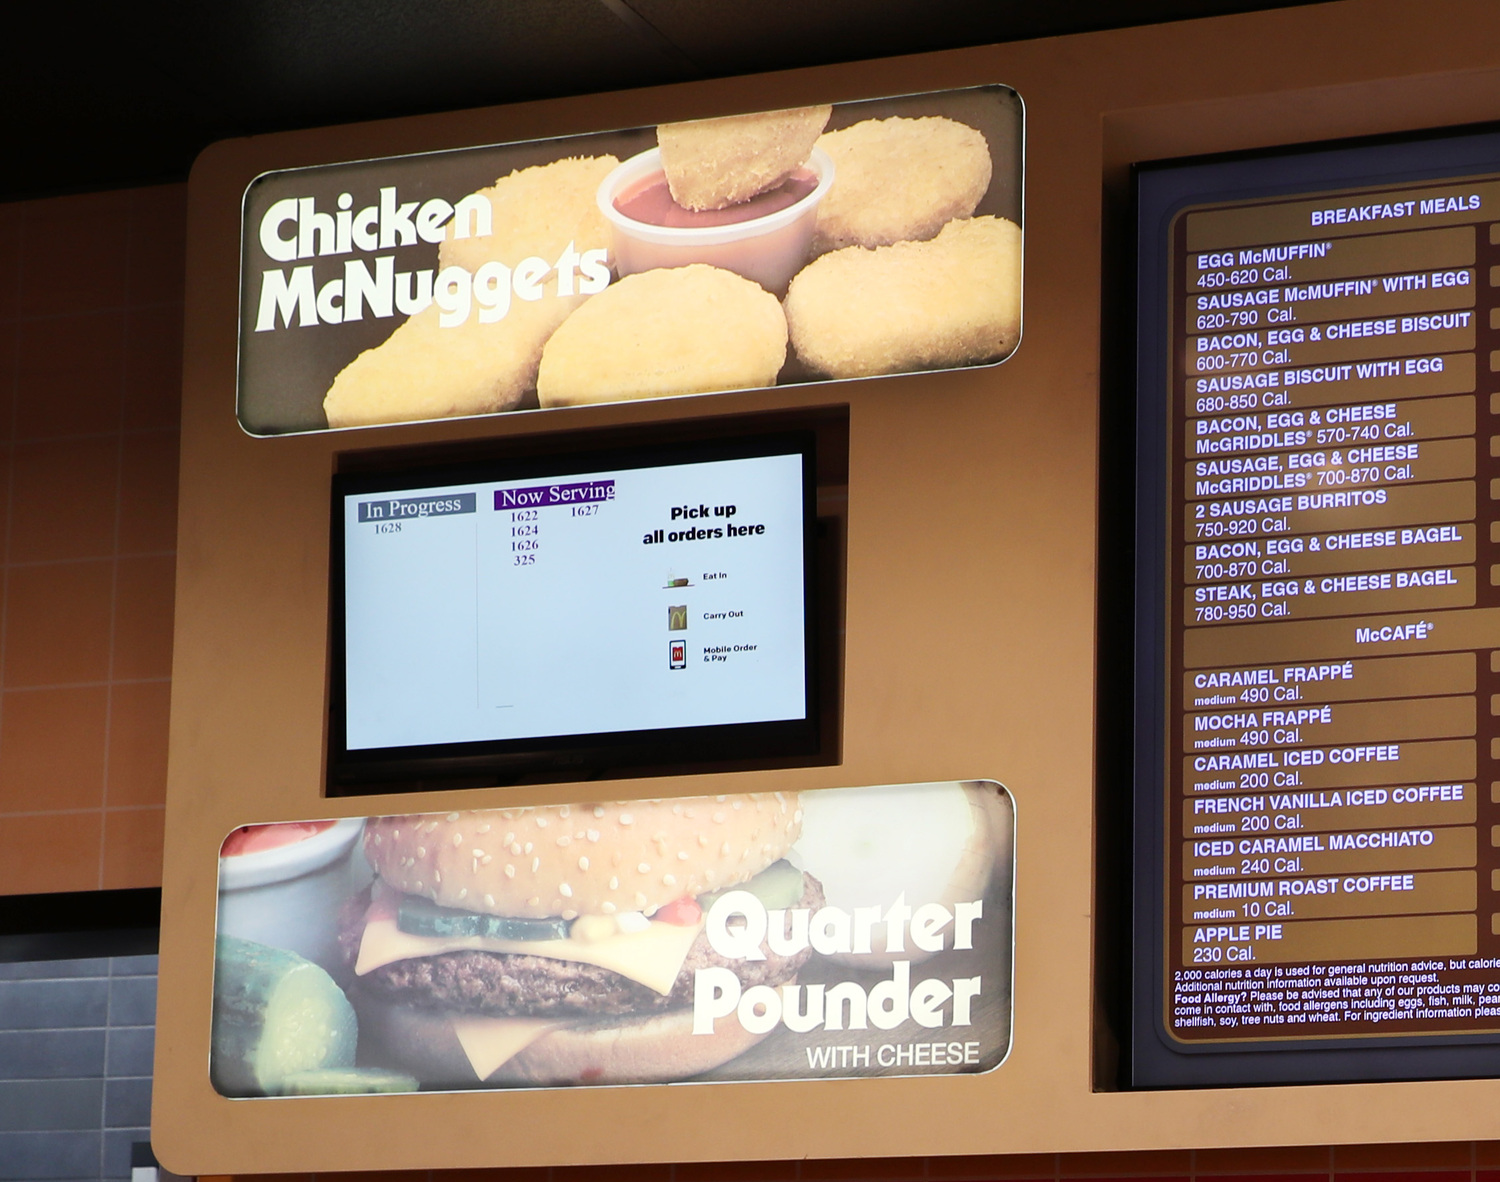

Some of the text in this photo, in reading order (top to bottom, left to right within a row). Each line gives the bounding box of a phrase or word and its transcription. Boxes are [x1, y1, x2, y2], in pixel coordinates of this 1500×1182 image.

[1311, 194, 1481, 226] BREAKFAST MEALS
[260, 187, 492, 261] Chicken
[1197, 252, 1234, 270] EGG
[255, 241, 609, 332] McNuggets
[1196, 265, 1292, 288] 450-620 Cal.
[1196, 311, 1472, 352] BACON, EGG & CHEESE BISCUIT
[1196, 348, 1291, 371] 600-770 Cal.
[502, 482, 615, 507] Now Serving
[1195, 488, 1388, 519] 2 SAUSAGE BURRITOS
[366, 497, 461, 518] In Progress
[510, 509, 539, 522] 1622
[570, 505, 600, 518] 1627
[671, 502, 737, 521] Pick up
[374, 522, 402, 535] 1628
[510, 524, 539, 537] 1624
[642, 521, 765, 545] all orders here
[510, 539, 539, 552] 1626
[513, 553, 536, 566] 325
[702, 571, 728, 581] Eat In
[1194, 569, 1458, 602] STEAK, EGG & CHEESE BAGEL
[703, 610, 744, 621] Carry Out
[1194, 600, 1290, 621] 780-950 Cal.
[703, 643, 758, 655] Mobile Order
[713, 653, 728, 663] Pay
[1194, 660, 1353, 689] CARAMEL FRAPPÉ
[1194, 684, 1303, 706] medium 490 Cal.
[1194, 784, 1464, 814] FRENCH VANILLA ICED COFFEE
[1193, 874, 1415, 900] PREMIUM ROAST COFFEE
[1193, 900, 1294, 920] medium 10 Cal.
[706, 891, 983, 961] Quarter
[1193, 923, 1283, 943] APPLE PIE
[1193, 945, 1256, 963] 230 Cal.
[1174, 969, 1202, 982] 2,000
[1204, 968, 1242, 979] calories
[1244, 969, 1252, 978] a
[1253, 967, 1272, 979] day
[1274, 966, 1283, 977] is
[1285, 964, 1310, 976] used
[1311, 965, 1326, 975] for
[1327, 963, 1366, 976] general
[1368, 961, 1408, 973] nutrition
[1410, 960, 1446, 972] advice,
[1449, 959, 1466, 970] but
[1174, 972, 1439, 992] Additional nutrition information available upon request.
[692, 962, 981, 1034] Pounder
[806, 1042, 980, 1068] WITH CHEESE
